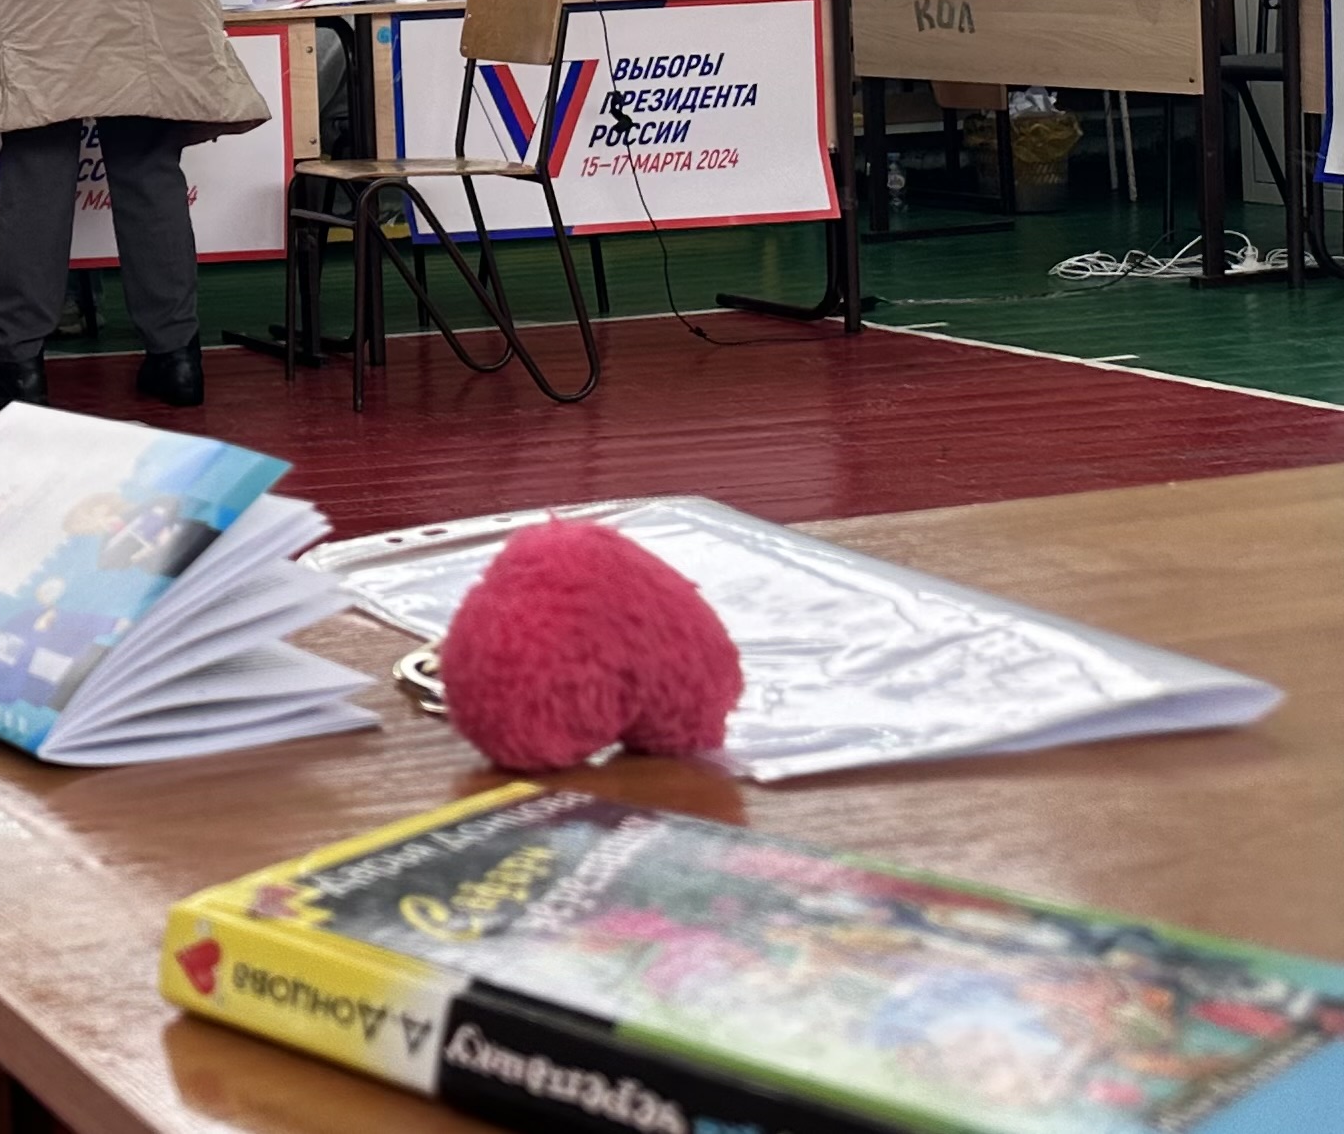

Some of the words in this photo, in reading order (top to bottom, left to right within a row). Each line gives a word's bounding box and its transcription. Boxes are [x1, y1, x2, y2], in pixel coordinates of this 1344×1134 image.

[614, 53, 725, 81] ВЫБОРЫ
[599, 83, 758, 115] ПРЕЗИДЕНТА
[588, 119, 691, 148] РОССИИ
[632, 150, 693, 175] МАРТА
[695, 148, 740, 171] 2024
